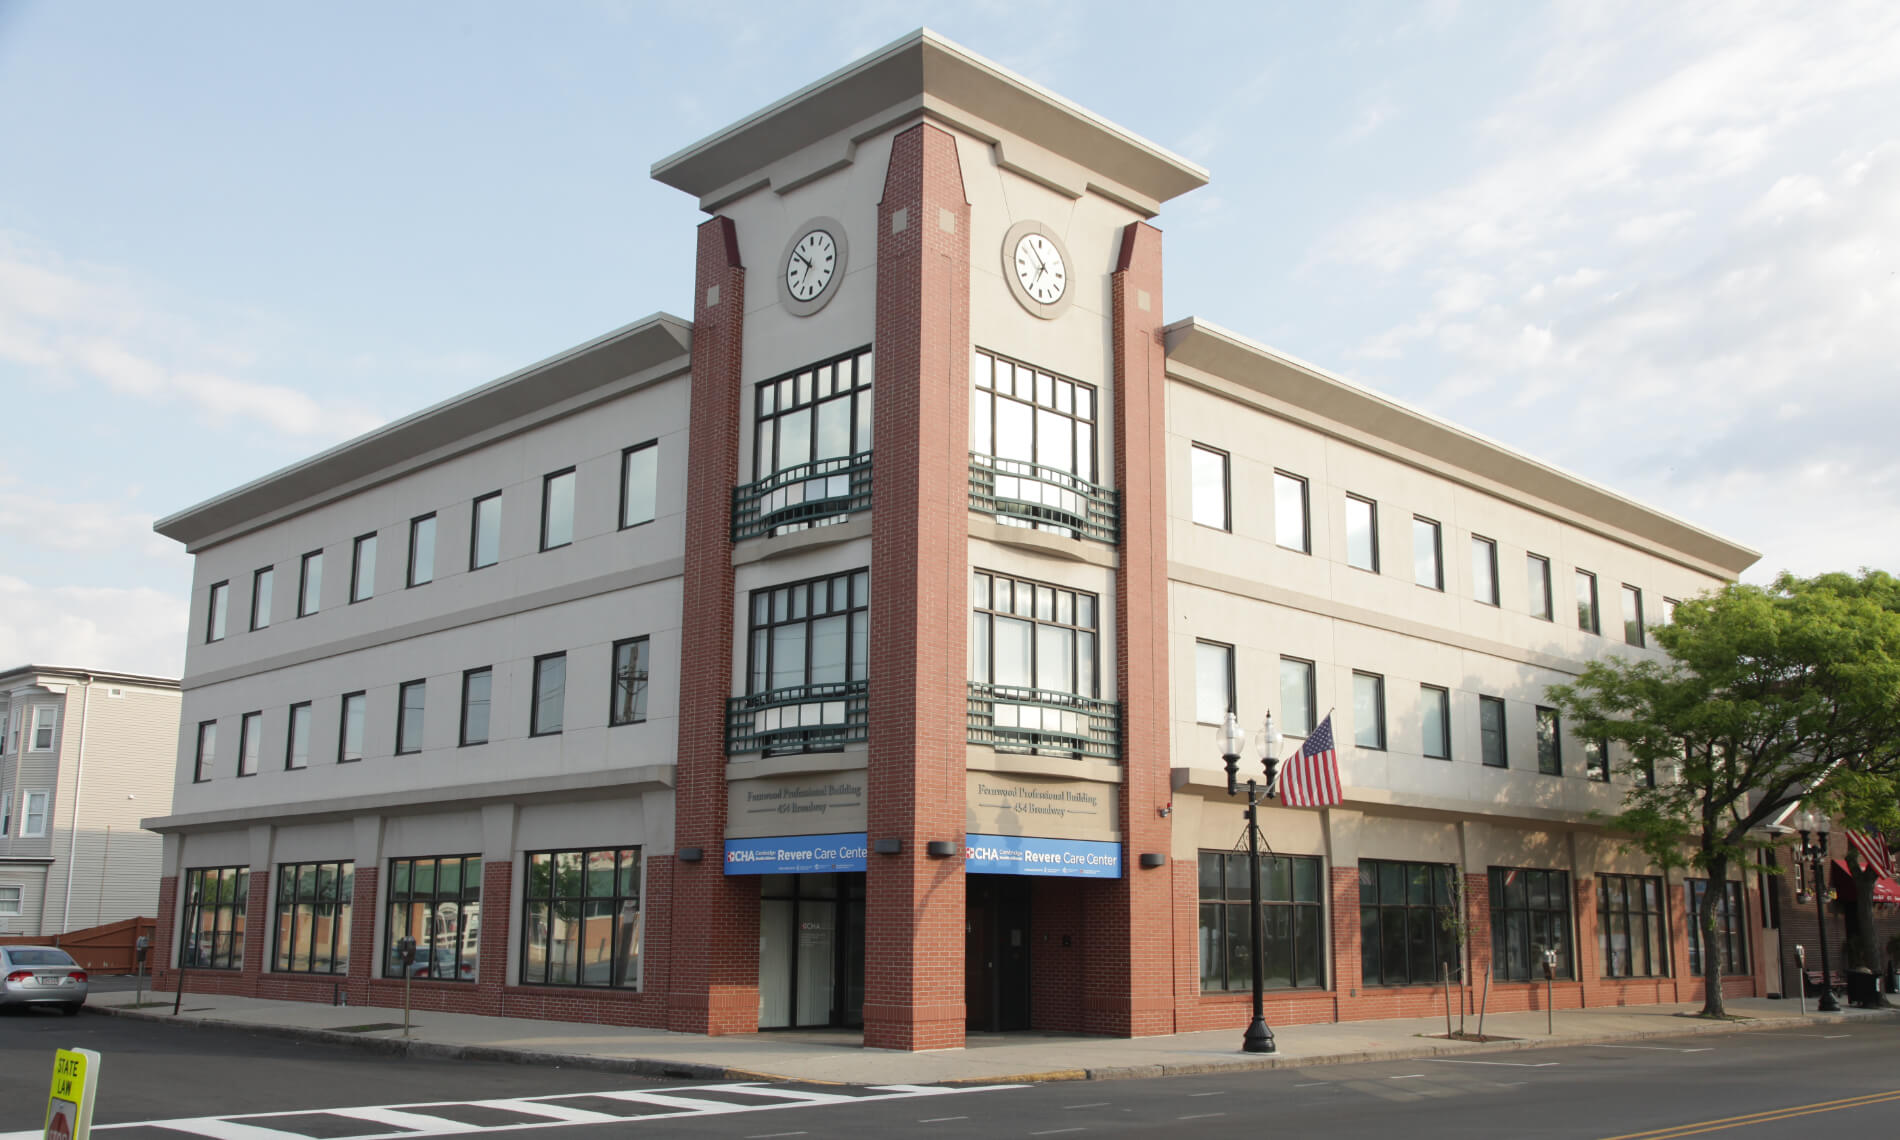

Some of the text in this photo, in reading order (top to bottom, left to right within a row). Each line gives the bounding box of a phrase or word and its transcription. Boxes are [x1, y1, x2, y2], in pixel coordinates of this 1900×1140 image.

[1019, 787, 1064, 801] Professional
[1066, 791, 1097, 806] Building
[1029, 803, 1066, 818] Broadway
[735, 850, 755, 862] CHA
[777, 849, 812, 861] Revere
[814, 847, 837, 859] Care
[839, 846, 867, 859] Cente
[975, 847, 1000, 861] CHA
[1024, 850, 1061, 863] Revere
[1063, 852, 1085, 865] Care
[1087, 853, 1117, 866] Center
[58, 1058, 79, 1077] STATE
[57, 1079, 72, 1096] LAW
